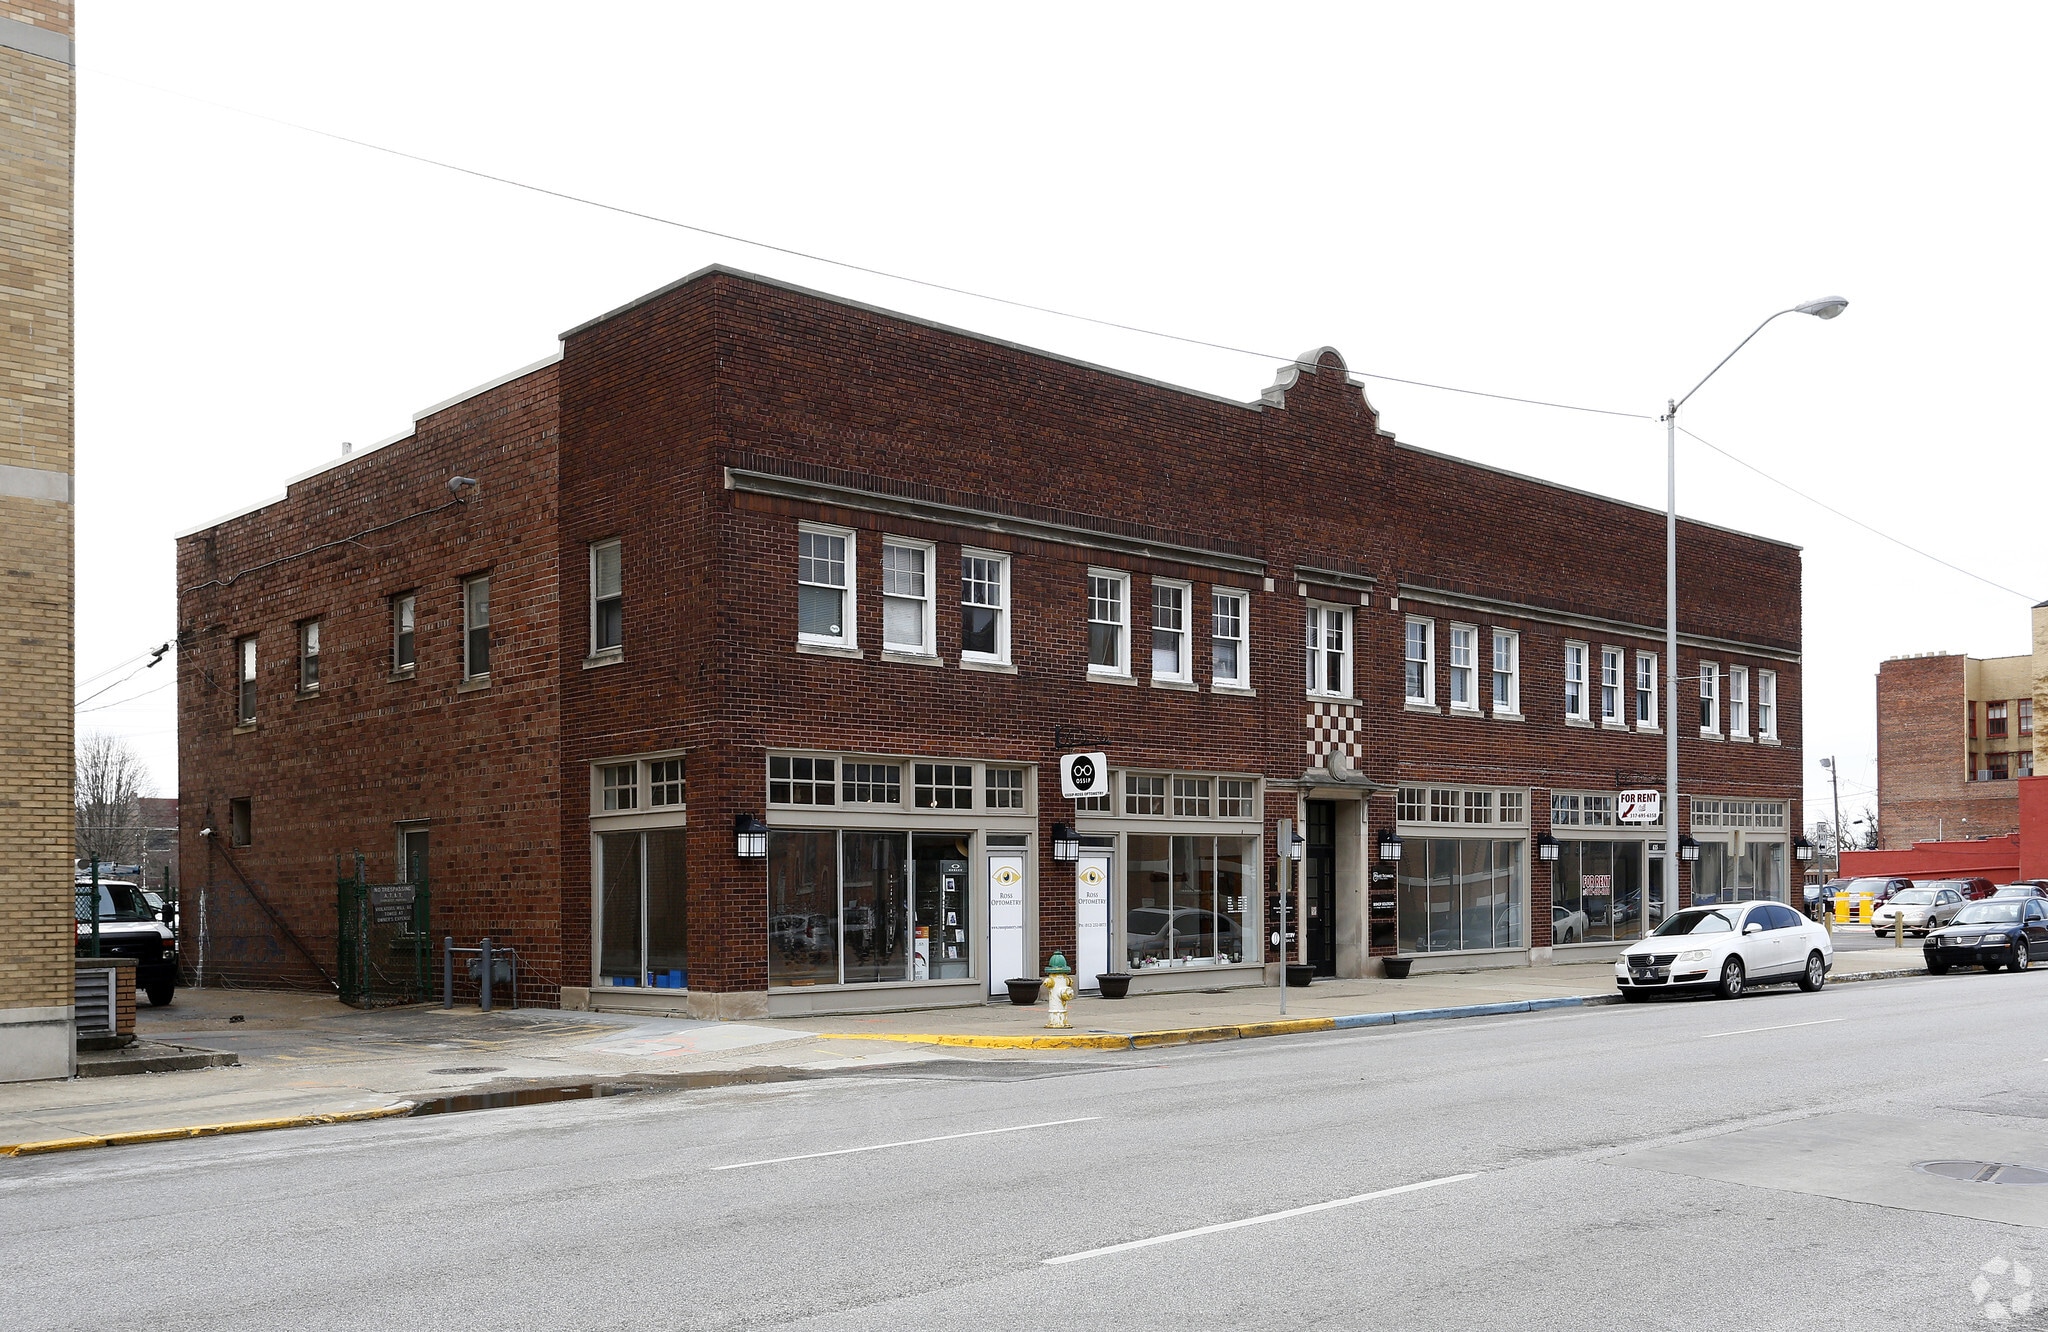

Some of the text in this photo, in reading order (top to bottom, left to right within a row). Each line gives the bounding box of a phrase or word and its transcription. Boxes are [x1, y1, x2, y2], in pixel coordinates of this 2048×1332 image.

[1620, 793, 1658, 803] FOR RENT
[1818, 824, 1826, 833] ONE
[1582, 874, 1611, 889] FOR RENT
